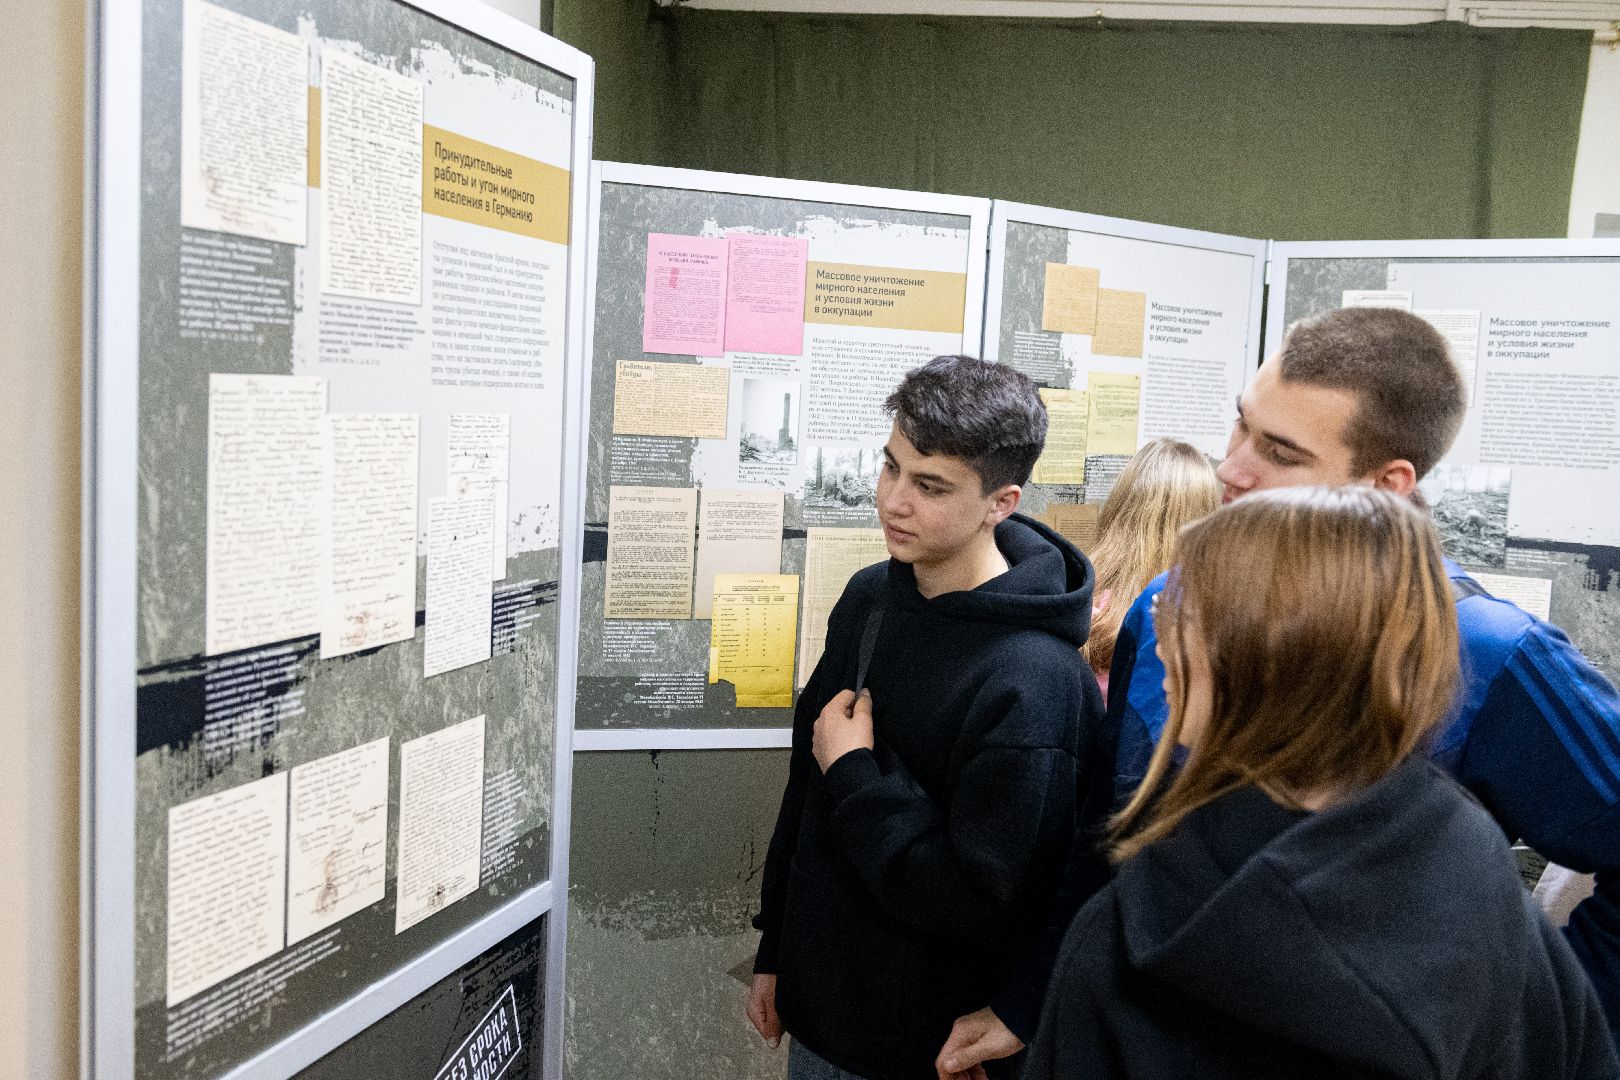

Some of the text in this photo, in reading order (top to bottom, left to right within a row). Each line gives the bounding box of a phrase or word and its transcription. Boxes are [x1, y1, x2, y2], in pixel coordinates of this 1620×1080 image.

[435, 141, 513, 180] Принудительные
[434, 167, 535, 205] работы и угон мирного
[434, 188, 533, 223] населения в Германию
[816, 269, 925, 287] Массовое уничтожение
[815, 282, 906, 297] мирного населения
[823, 295, 862, 305] условия
[864, 299, 894, 307] жизни
[822, 307, 873, 317] оккупации
[1151, 302, 1223, 318] Массовое уничтожение
[1151, 315, 1210, 326] мирного населения
[1490, 317, 1611, 328] Массовое уничтожение
[1156, 324, 1181, 333] условия
[1183, 327, 1203, 335] жизни
[1489, 330, 1531, 338] мирного
[1154, 335, 1188, 344] оккупации
[1497, 341, 1538, 349] условия
[1495, 351, 1550, 360] оккупации
[445, 1006, 508, 1080] ЕЗ СРОКА
